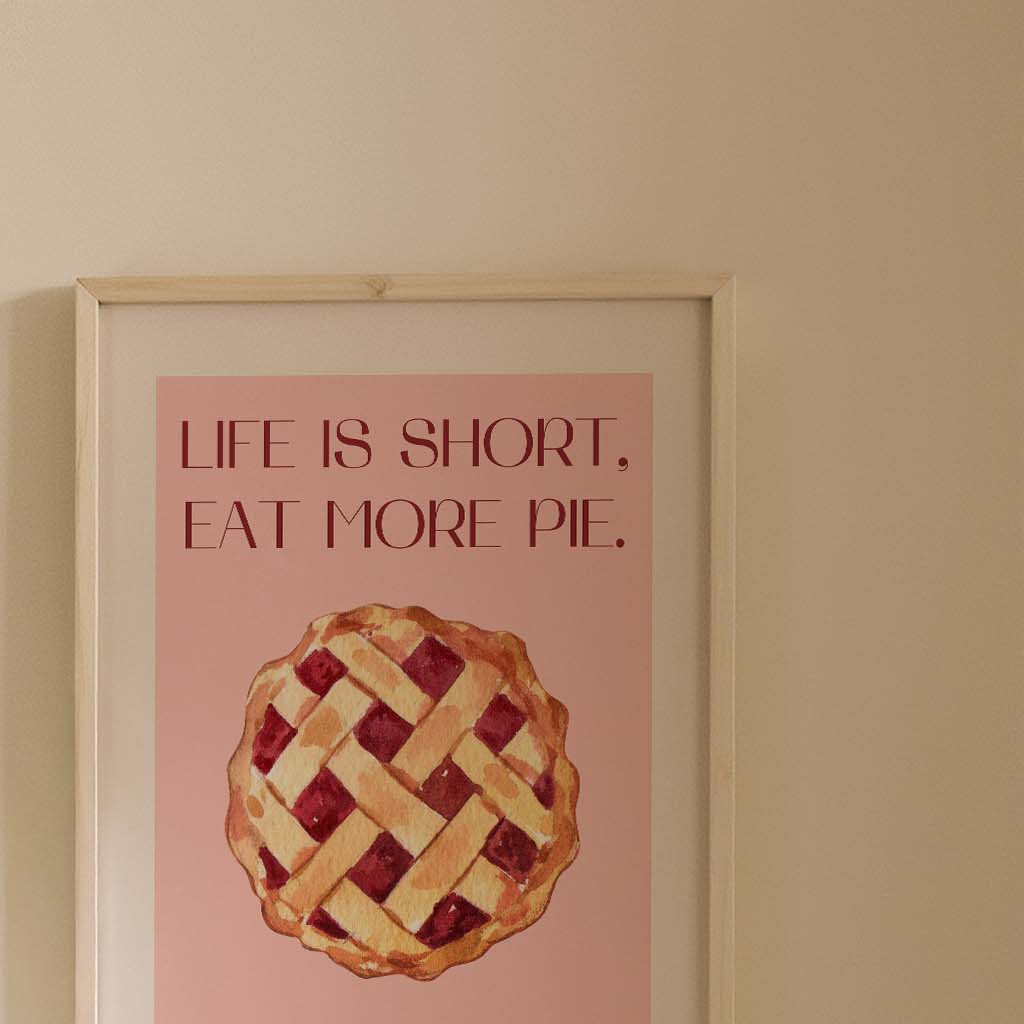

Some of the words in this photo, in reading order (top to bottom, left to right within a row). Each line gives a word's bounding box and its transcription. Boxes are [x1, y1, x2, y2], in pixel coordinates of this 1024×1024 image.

[181, 420, 295, 469] LIFE
[322, 418, 373, 469] IS
[399, 417, 629, 472] SHORT,
[184, 500, 301, 549] EAT
[326, 499, 502, 549] MORE
[528, 498, 625, 549] PIE.
